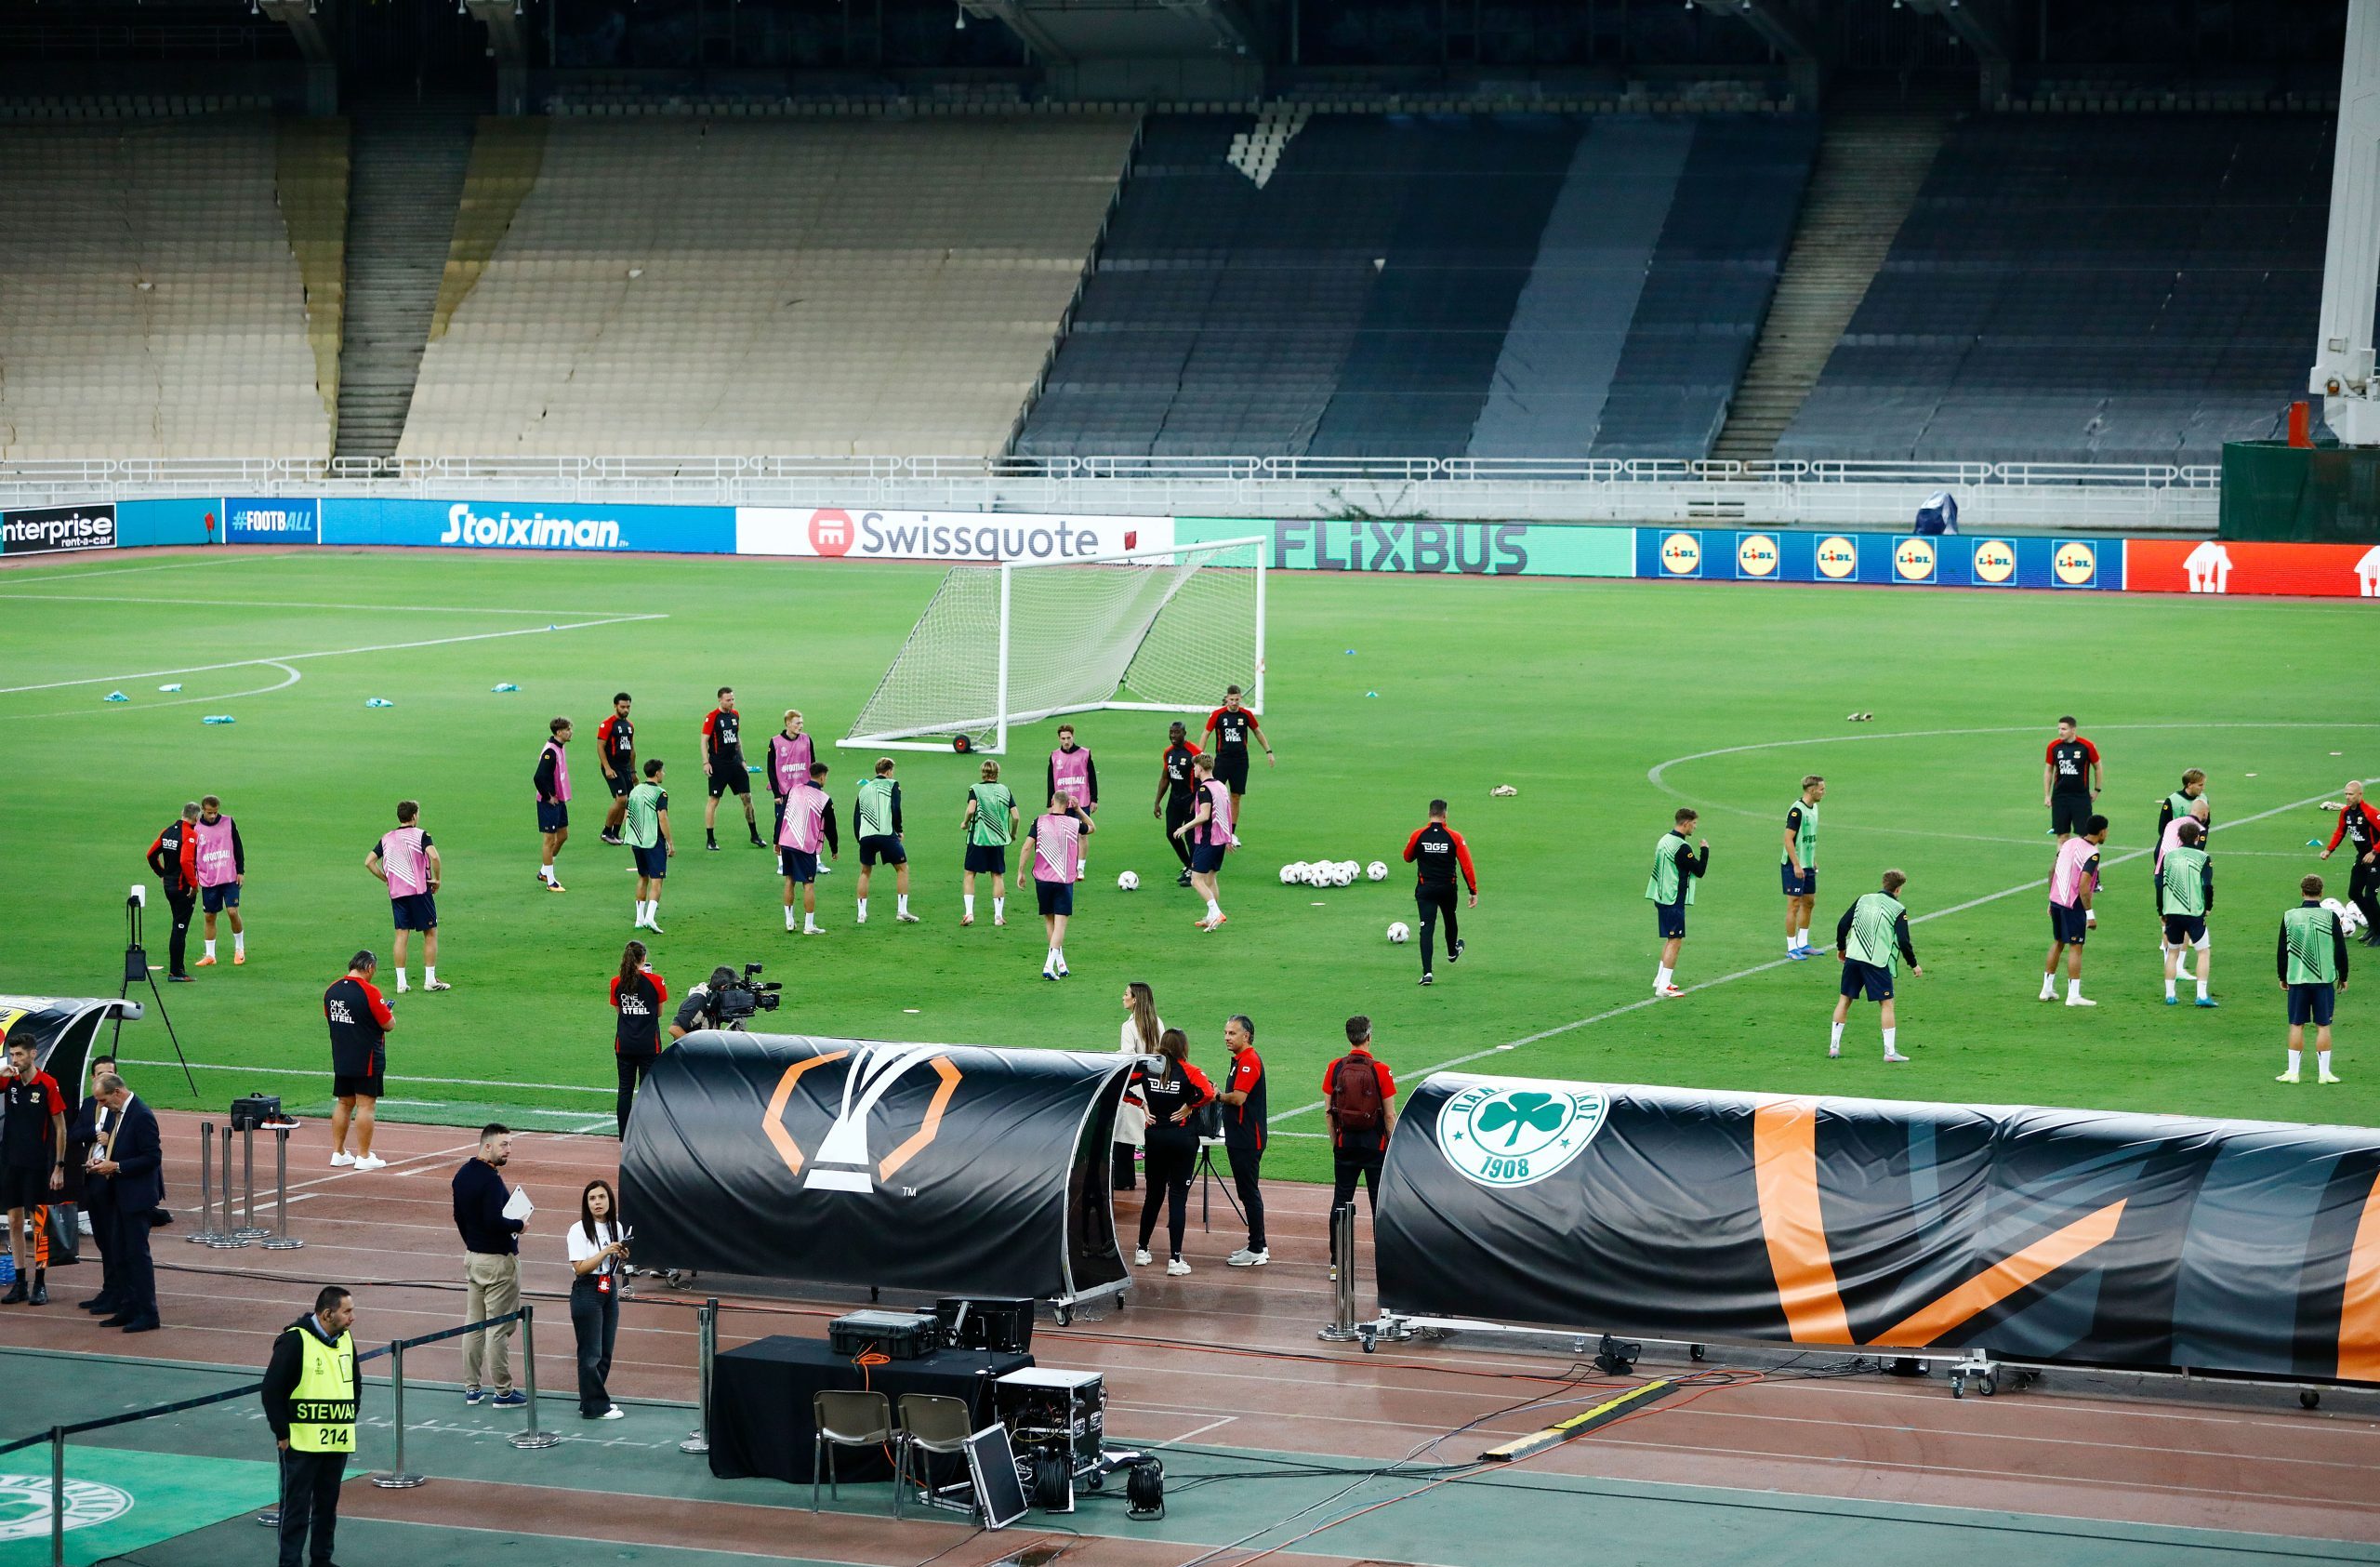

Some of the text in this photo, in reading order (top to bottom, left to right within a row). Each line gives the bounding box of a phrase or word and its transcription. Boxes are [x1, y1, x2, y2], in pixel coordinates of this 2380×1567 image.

[232, 511, 312, 531] #FOOTBALL
[441, 503, 620, 547] Stoiximan
[0, 513, 112, 545] nterprise
[61, 537, 112, 547] rent-a-car
[862, 512, 1099, 560] Swissquote
[1421, 843, 1448, 851] DGS
[330, 1000, 345, 1009] ONE
[621, 1000, 644, 1008] CLICK
[330, 1007, 350, 1016] CLICK
[331, 1015, 354, 1024] STEEL
[1480, 1156, 1529, 1179] 1908
[902, 1187, 917, 1197] TM
[298, 1403, 355, 1420] STEWA
[320, 1428, 348, 1444] 214
